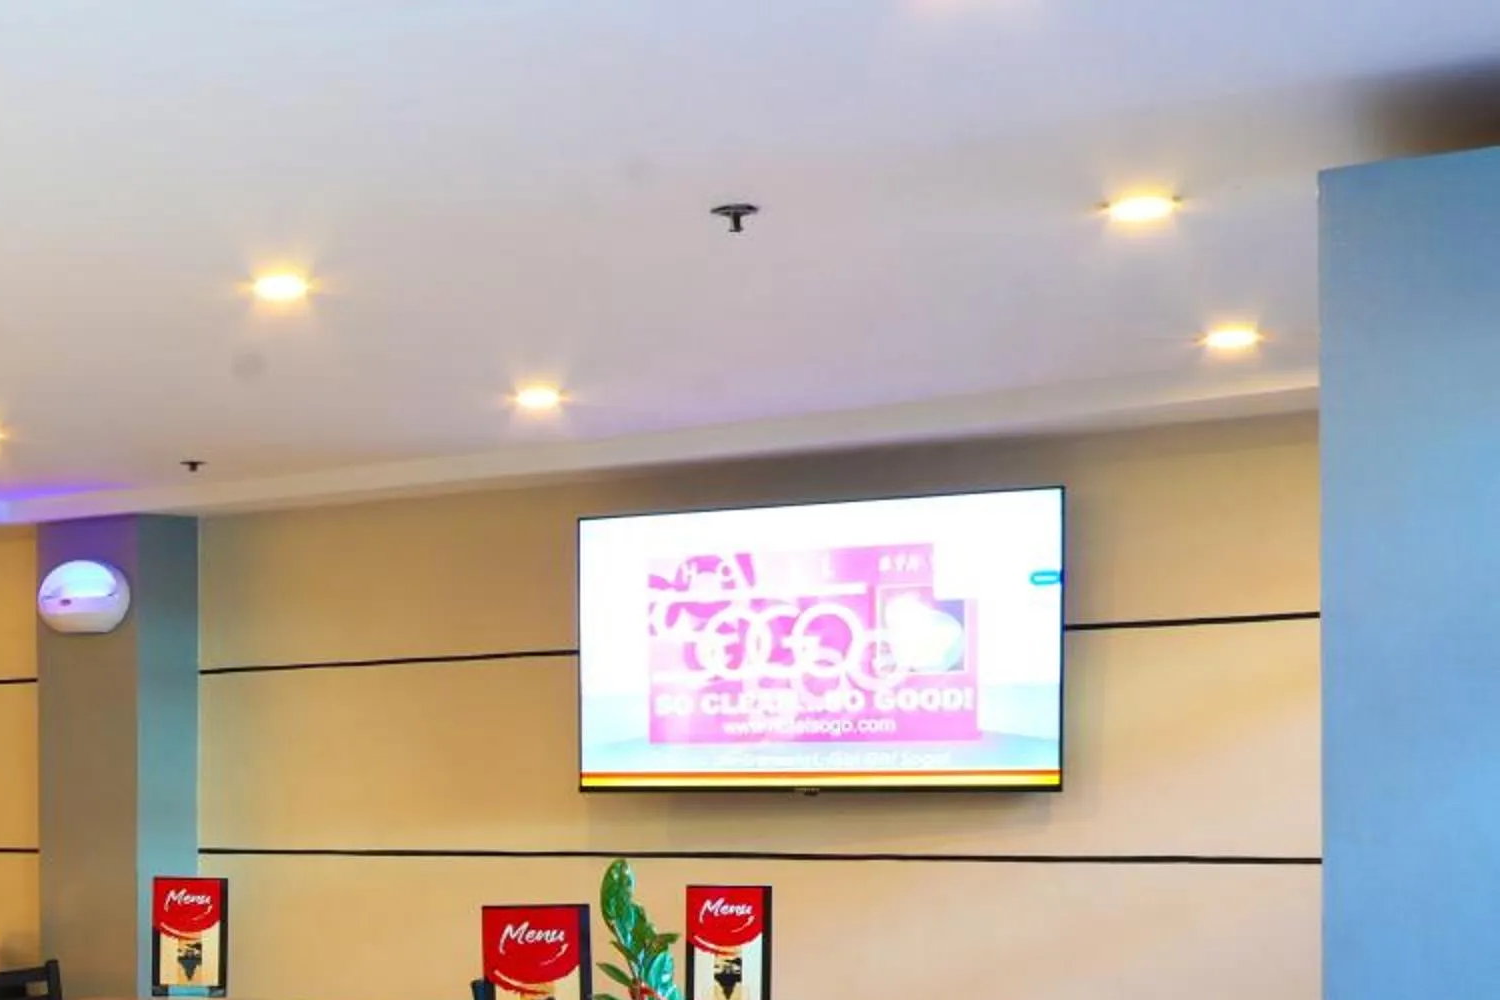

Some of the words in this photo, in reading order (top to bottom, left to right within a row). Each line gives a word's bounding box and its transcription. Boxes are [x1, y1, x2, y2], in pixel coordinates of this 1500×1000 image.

[874, 687, 974, 712] GOOD!
[164, 888, 211, 912] Menu
[699, 897, 753, 924] Menu
[499, 921, 565, 955] Menu
